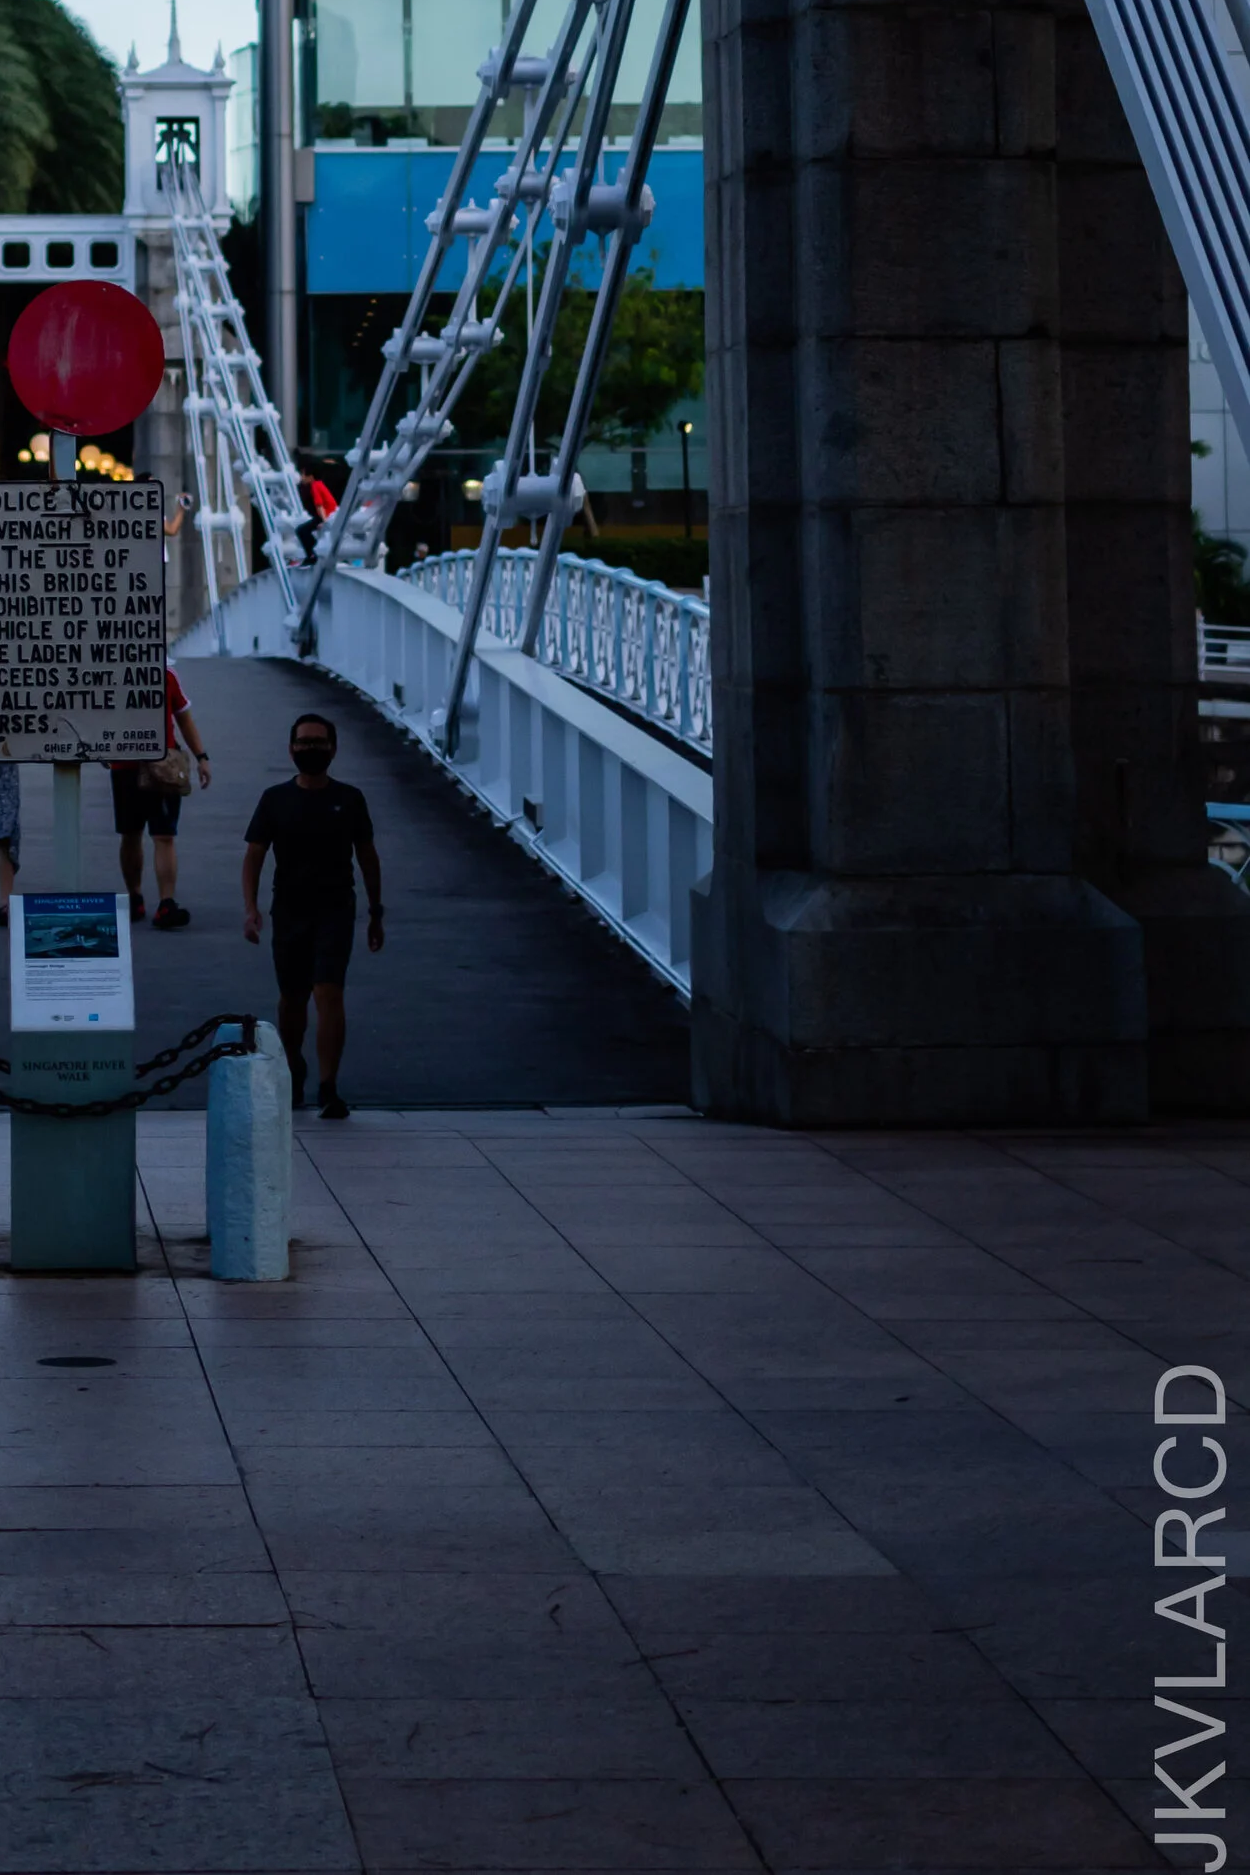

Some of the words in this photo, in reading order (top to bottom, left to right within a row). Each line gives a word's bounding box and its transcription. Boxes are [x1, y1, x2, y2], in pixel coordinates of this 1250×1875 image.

[71, 490, 160, 511] NOTICE
[83, 520, 157, 539] BRIDGE
[56, 549, 94, 569] USE
[105, 549, 130, 568] OF
[44, 573, 117, 592] BRIDGE
[129, 572, 148, 592] IS
[91, 596, 116, 616] TO
[124, 595, 163, 615] ANY
[63, 620, 88, 640] OF
[97, 620, 160, 639] WHICH
[17, 644, 82, 663] LADEN
[90, 643, 163, 663] WEIGHT
[67, 667, 79, 687] 3
[82, 671, 117, 686] CWT.
[123, 667, 162, 686] AND
[1, 691, 38, 710] ALL
[43, 691, 115, 710] CATTLE
[125, 690, 164, 709] AND
[102, 731, 115, 740] BY
[123, 730, 157, 740] ORDER
[44, 743, 73, 753] CHIEF
[21, 1060, 86, 1071] SINGAPORE
[92, 1059, 126, 1071] RIVER
[57, 1072, 90, 1082] WALK
